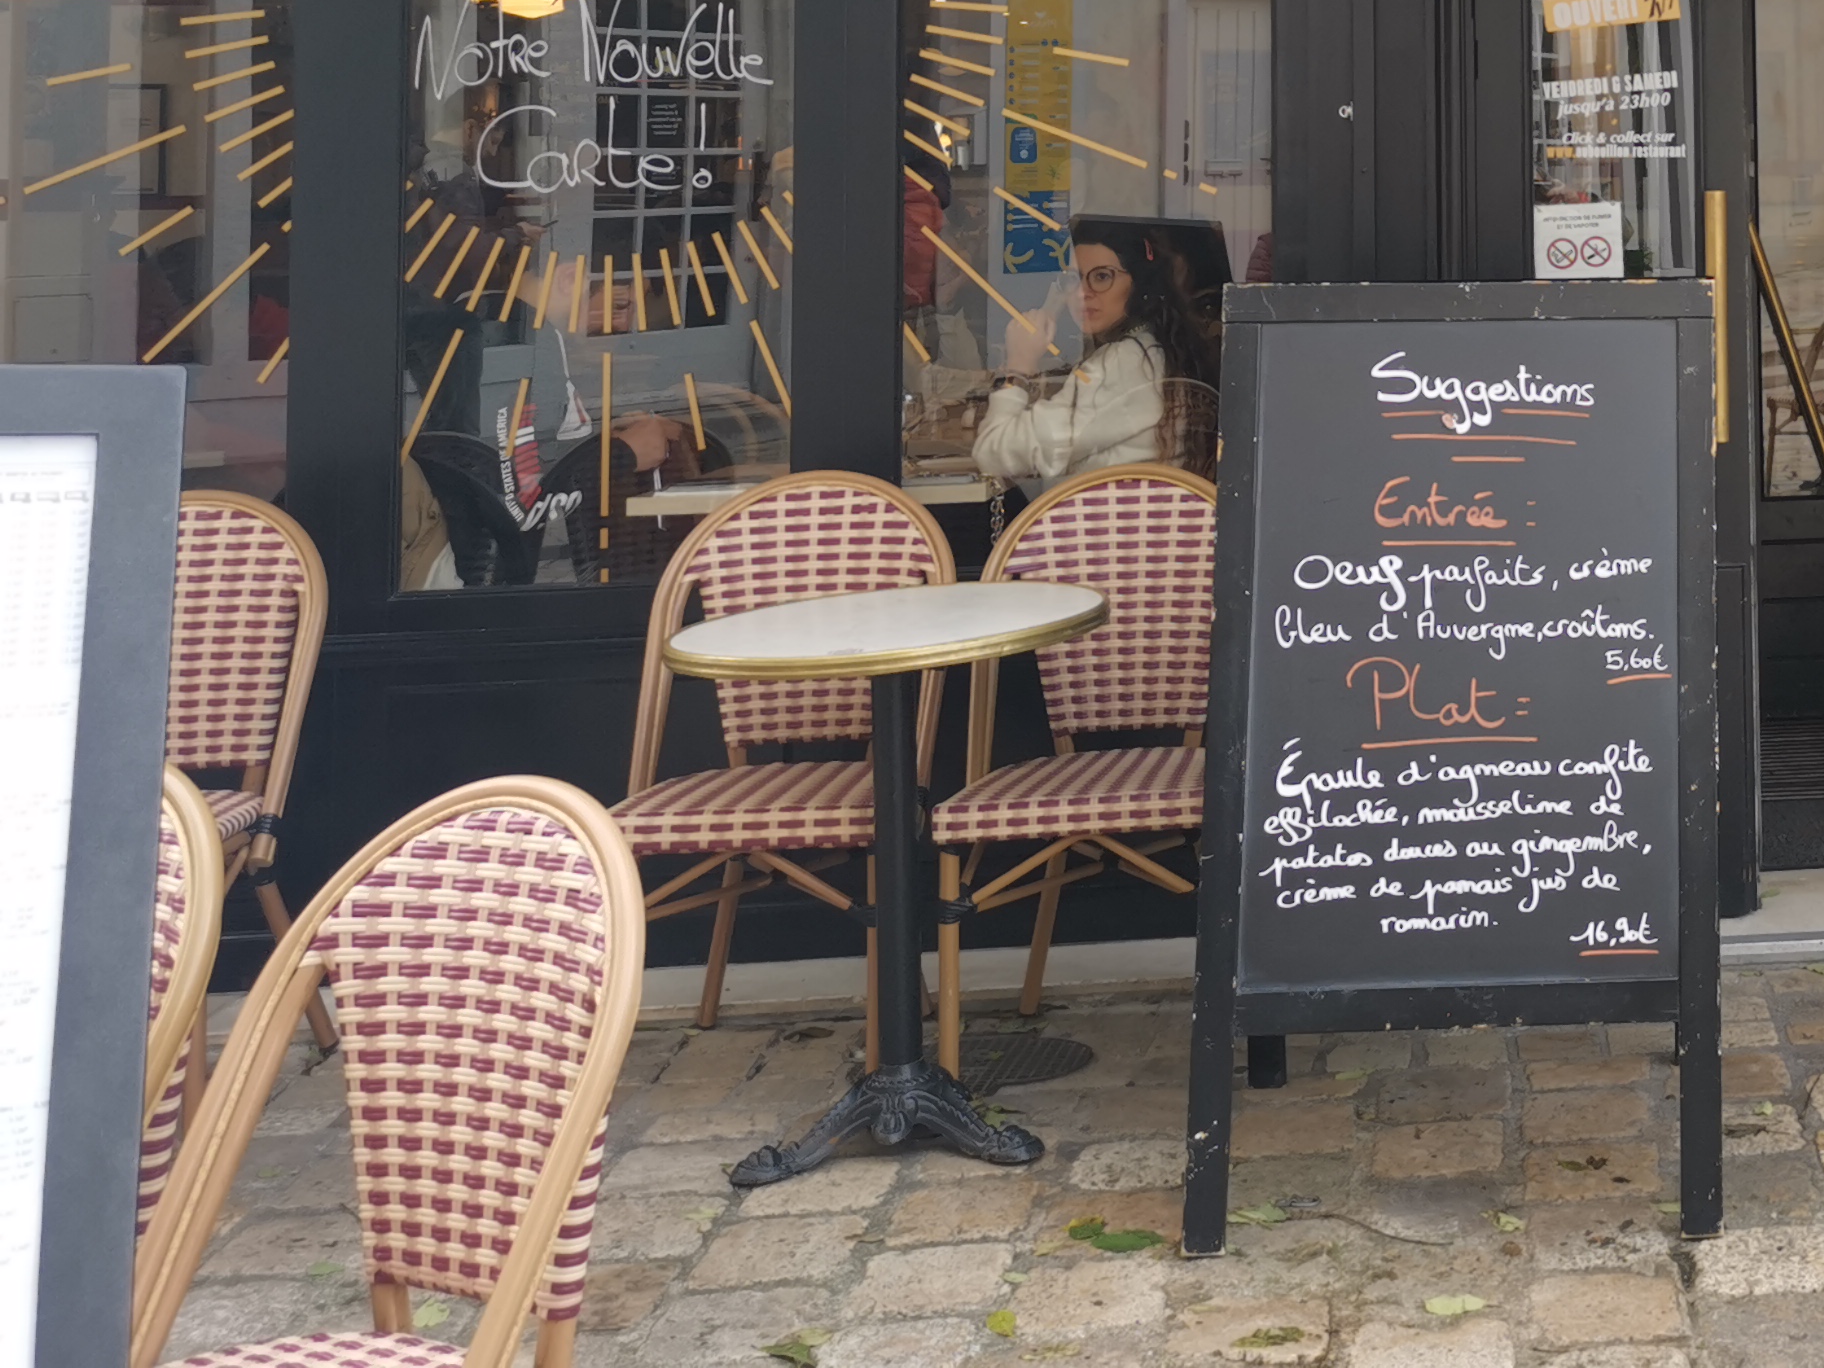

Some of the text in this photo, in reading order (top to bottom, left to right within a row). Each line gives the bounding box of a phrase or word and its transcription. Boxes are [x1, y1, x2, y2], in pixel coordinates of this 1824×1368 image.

[1543, 77, 1609, 99] VENDREDI
[1624, 70, 1678, 92] SAMEDI
[1619, 92, 1671, 110] 23h00
[1562, 131, 1675, 145] Click & collect sur
[1371, 352, 1595, 433] Suggestions
[497, 407, 509, 447] AMERICA
[501, 461, 515, 493] STATES
[1374, 476, 1508, 528] Entrée
[1569, 548, 1653, 581] crème
[1346, 656, 1507, 730] Plat
[1558, 739, 1653, 800] confite
[1418, 790, 1572, 825] mousseline
[1589, 794, 1625, 816] de
[1465, 840, 1505, 858] au
[1277, 879, 1357, 908] crème
[1370, 877, 1403, 897] de
[1518, 867, 1568, 913] jus
[1581, 867, 1621, 892] de
